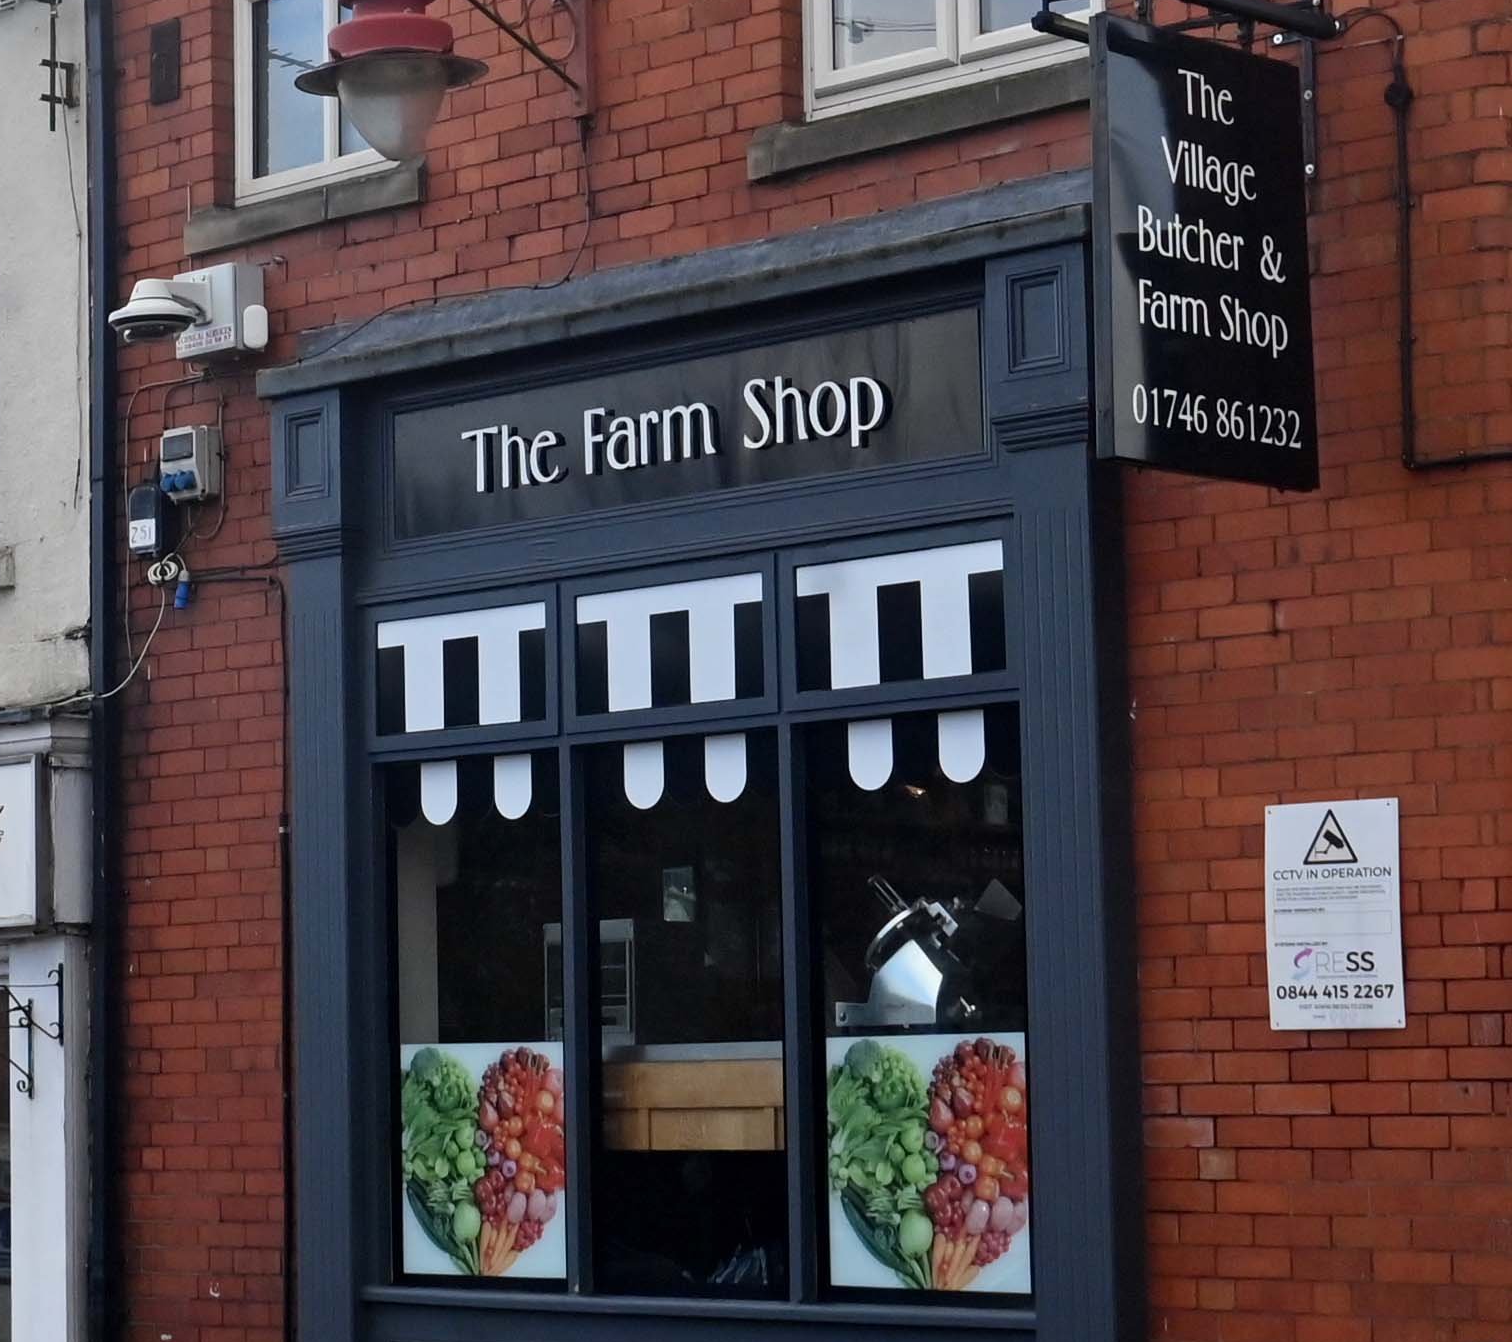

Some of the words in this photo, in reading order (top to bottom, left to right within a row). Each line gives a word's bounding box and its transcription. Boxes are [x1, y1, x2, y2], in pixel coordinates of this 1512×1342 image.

[1178, 67, 1235, 126] The
[1161, 136, 1257, 207] Village
[1137, 205, 1245, 272] Butcher
[1260, 234, 1287, 284] &
[1138, 279, 1211, 339] Farm
[1219, 294, 1289, 359] Shop
[461, 423, 561, 494] The
[583, 400, 718, 476] Farm
[743, 375, 886, 451] Shop
[1132, 383, 1209, 435] 01746
[1215, 397, 1303, 450] 861232
[1273, 869, 1304, 881] CCTV
[1306, 868, 1319, 880] IN
[1321, 866, 1393, 879] OPERATION
[1276, 985, 1318, 1000] 0844
[1322, 984, 1349, 999] 415
[1353, 983, 1395, 999] 2267
[1315, 950, 1375, 973] RESS
